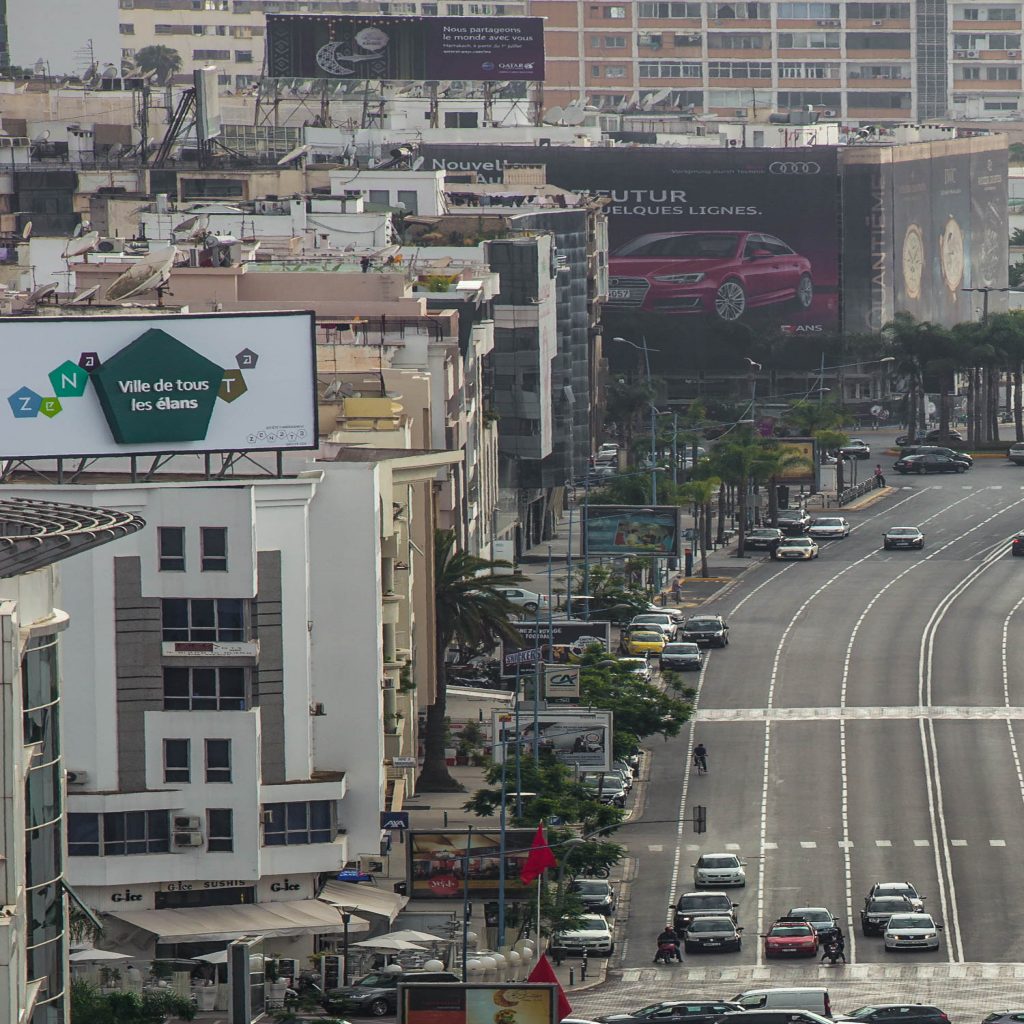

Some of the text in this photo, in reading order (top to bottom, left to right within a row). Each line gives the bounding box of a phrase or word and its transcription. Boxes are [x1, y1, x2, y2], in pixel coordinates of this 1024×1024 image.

[470, 26, 521, 34] partageons
[689, 206, 762, 215] LIGNES.
[118, 379, 209, 394] Ville de tous
[131, 397, 198, 411] les élans
[383, 819, 405, 828] AXA
[203, 880, 246, 889] SUSHIS
